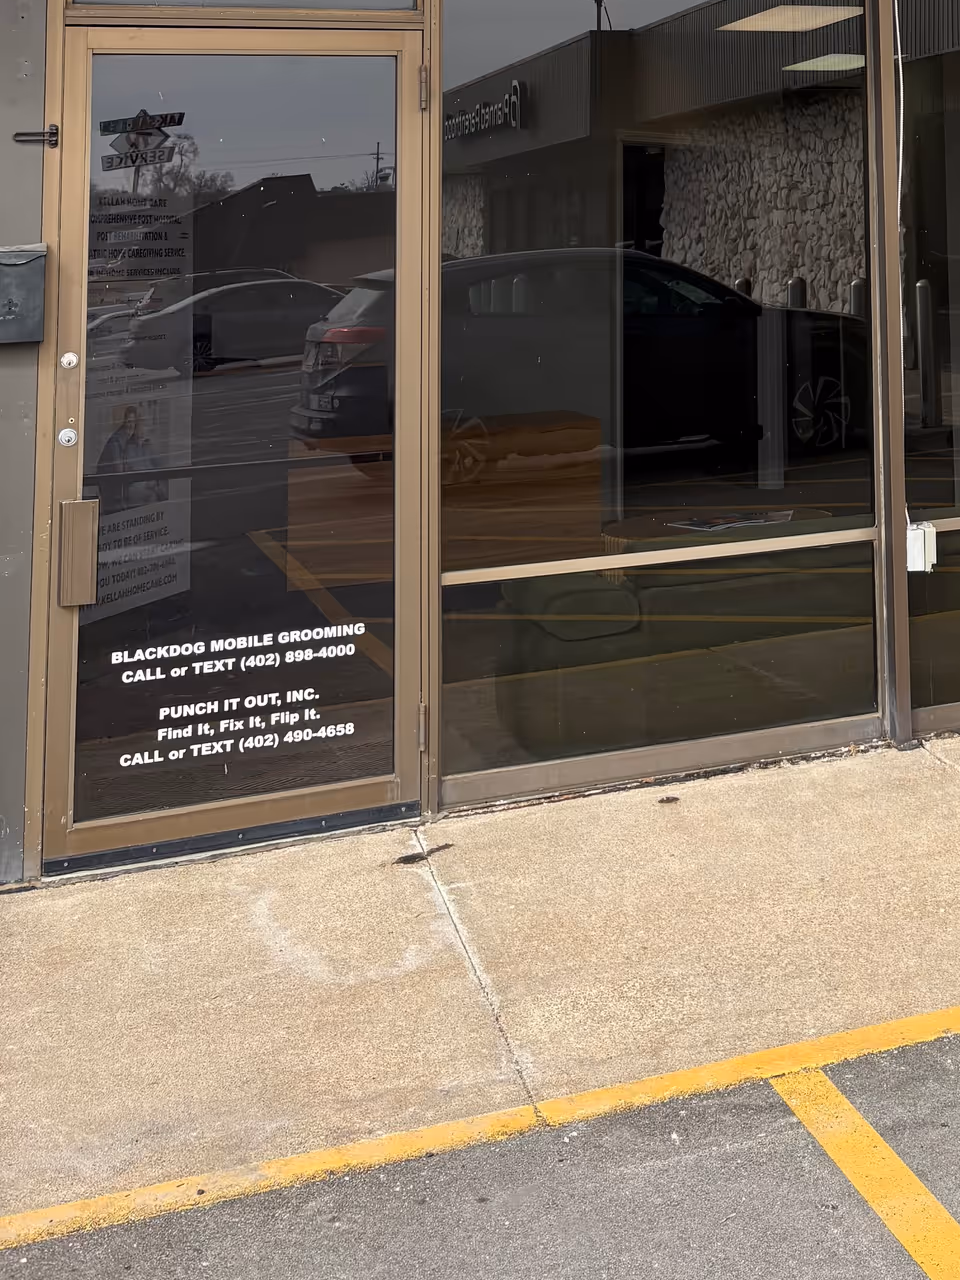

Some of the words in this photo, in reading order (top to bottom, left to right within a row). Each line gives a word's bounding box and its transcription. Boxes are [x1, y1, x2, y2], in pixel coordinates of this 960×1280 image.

[111, 641, 205, 664] BLACKDOG
[210, 633, 273, 652] MOBILE
[278, 623, 366, 644] GROOMING
[121, 667, 166, 683] CALL
[170, 666, 188, 678] or
[192, 658, 236, 675] TEXT
[240, 652, 280, 672] (402)
[285, 643, 355, 663] 898-4000
[159, 700, 219, 720] PUNCH
[224, 698, 240, 712] IT
[244, 693, 281, 709] OUT,
[286, 688, 320, 703] INC.
[120, 750, 164, 767] CALL
[168, 749, 187, 761] or
[190, 739, 234, 757] TEXT
[239, 733, 279, 753] (402)
[283, 722, 355, 743] 490-4658
[158, 723, 193, 741] Find
[198, 722, 215, 737] It,
[219, 719, 244, 733] Fix
[249, 716, 266, 729] It,
[270, 711, 299, 726] Flip
[304, 708, 321, 721] It.
